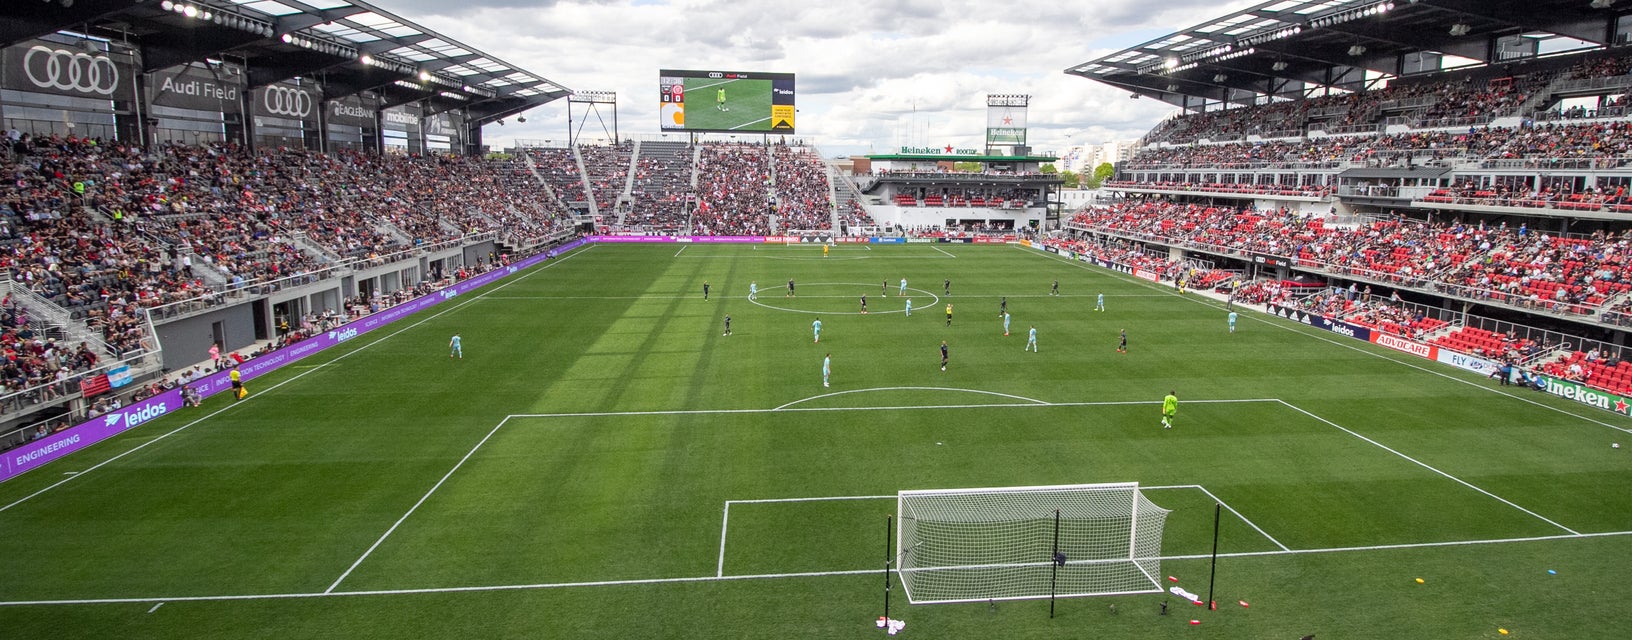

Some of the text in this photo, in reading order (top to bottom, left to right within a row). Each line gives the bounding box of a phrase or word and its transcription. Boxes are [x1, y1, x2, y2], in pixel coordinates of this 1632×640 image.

[161, 77, 236, 100] Audi Field
[901, 146, 941, 154] Heineken
[337, 326, 357, 342] leidos
[1332, 322, 1354, 338] leidos
[253, 354, 285, 371] TECHNOLOGY
[289, 341, 319, 358] ENGINEERING
[1378, 335, 1430, 357] ADVOCARE
[1452, 355, 1467, 366] FLY
[1543, 377, 1609, 409] ineken
[124, 402, 167, 428] leidos
[16, 434, 81, 466] ENGINEERING
